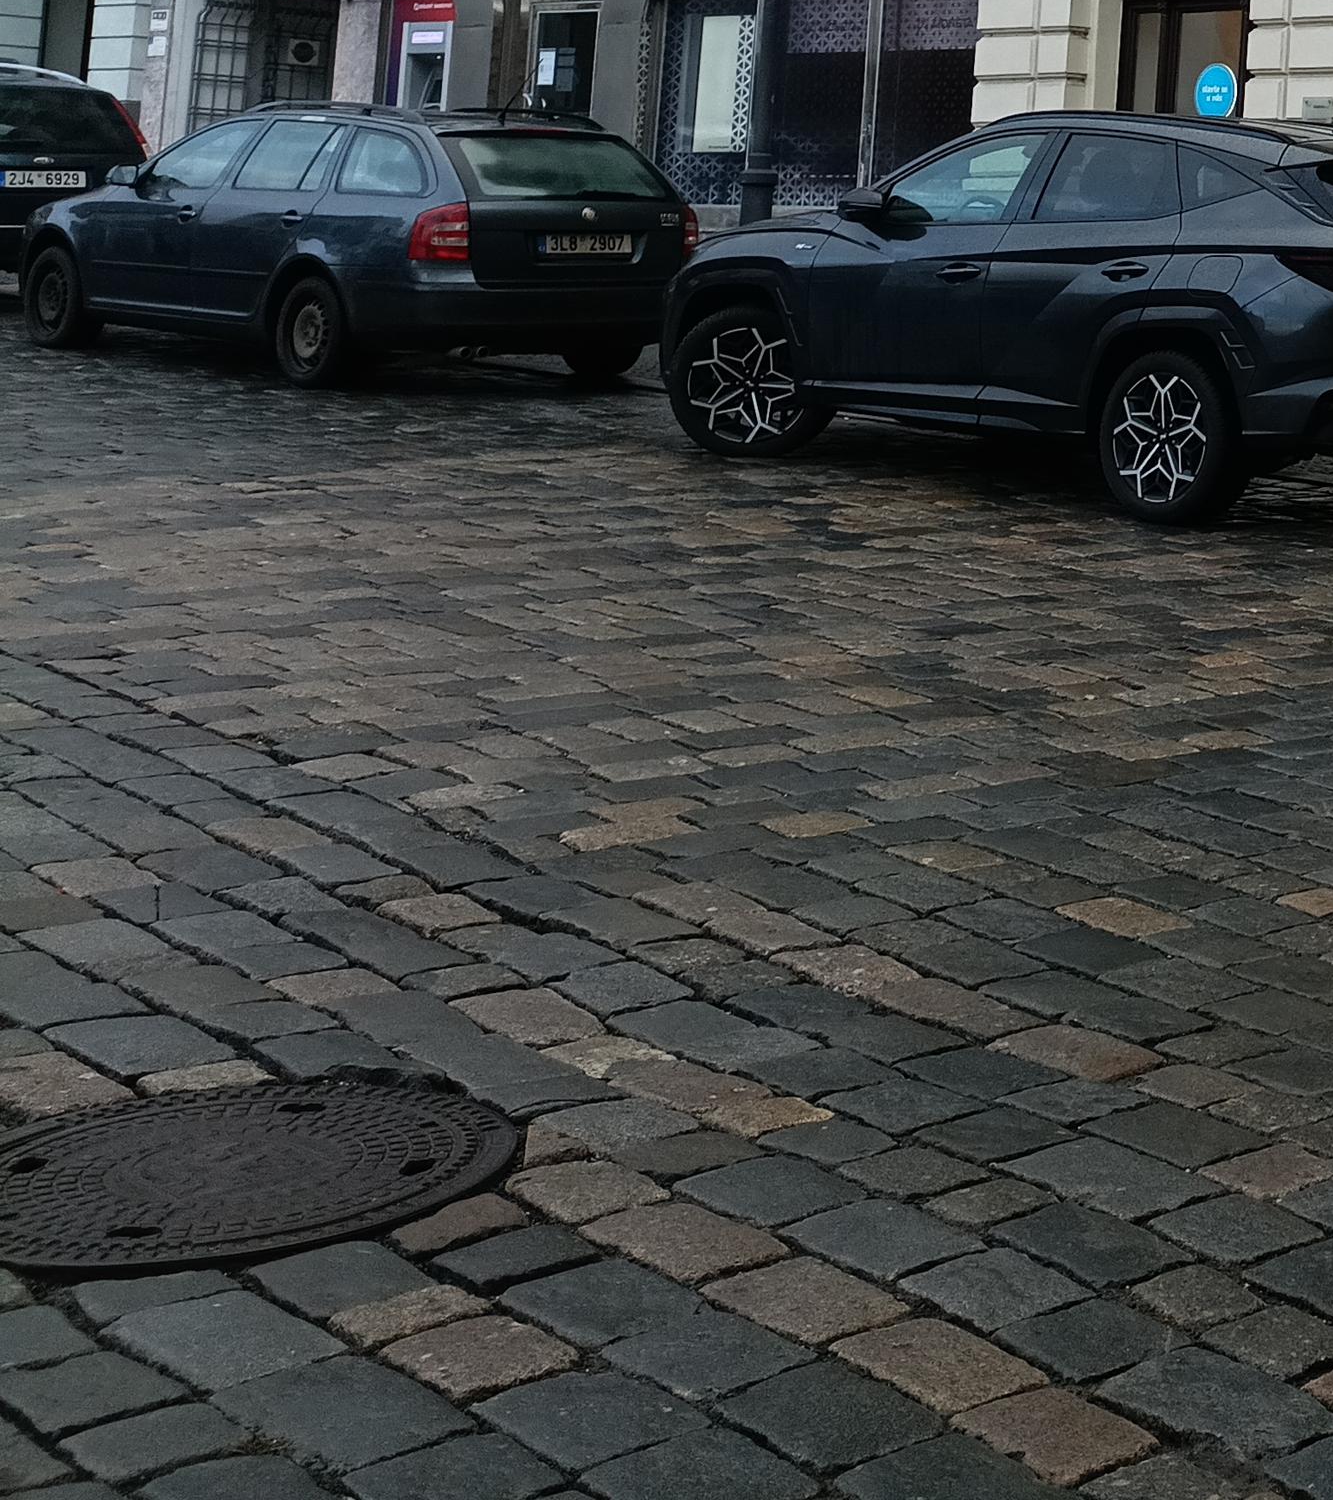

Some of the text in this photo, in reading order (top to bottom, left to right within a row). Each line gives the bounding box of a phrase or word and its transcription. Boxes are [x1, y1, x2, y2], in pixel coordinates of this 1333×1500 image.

[8, 172, 80, 186] 2J4 6929
[550, 234, 578, 251] 3L8
